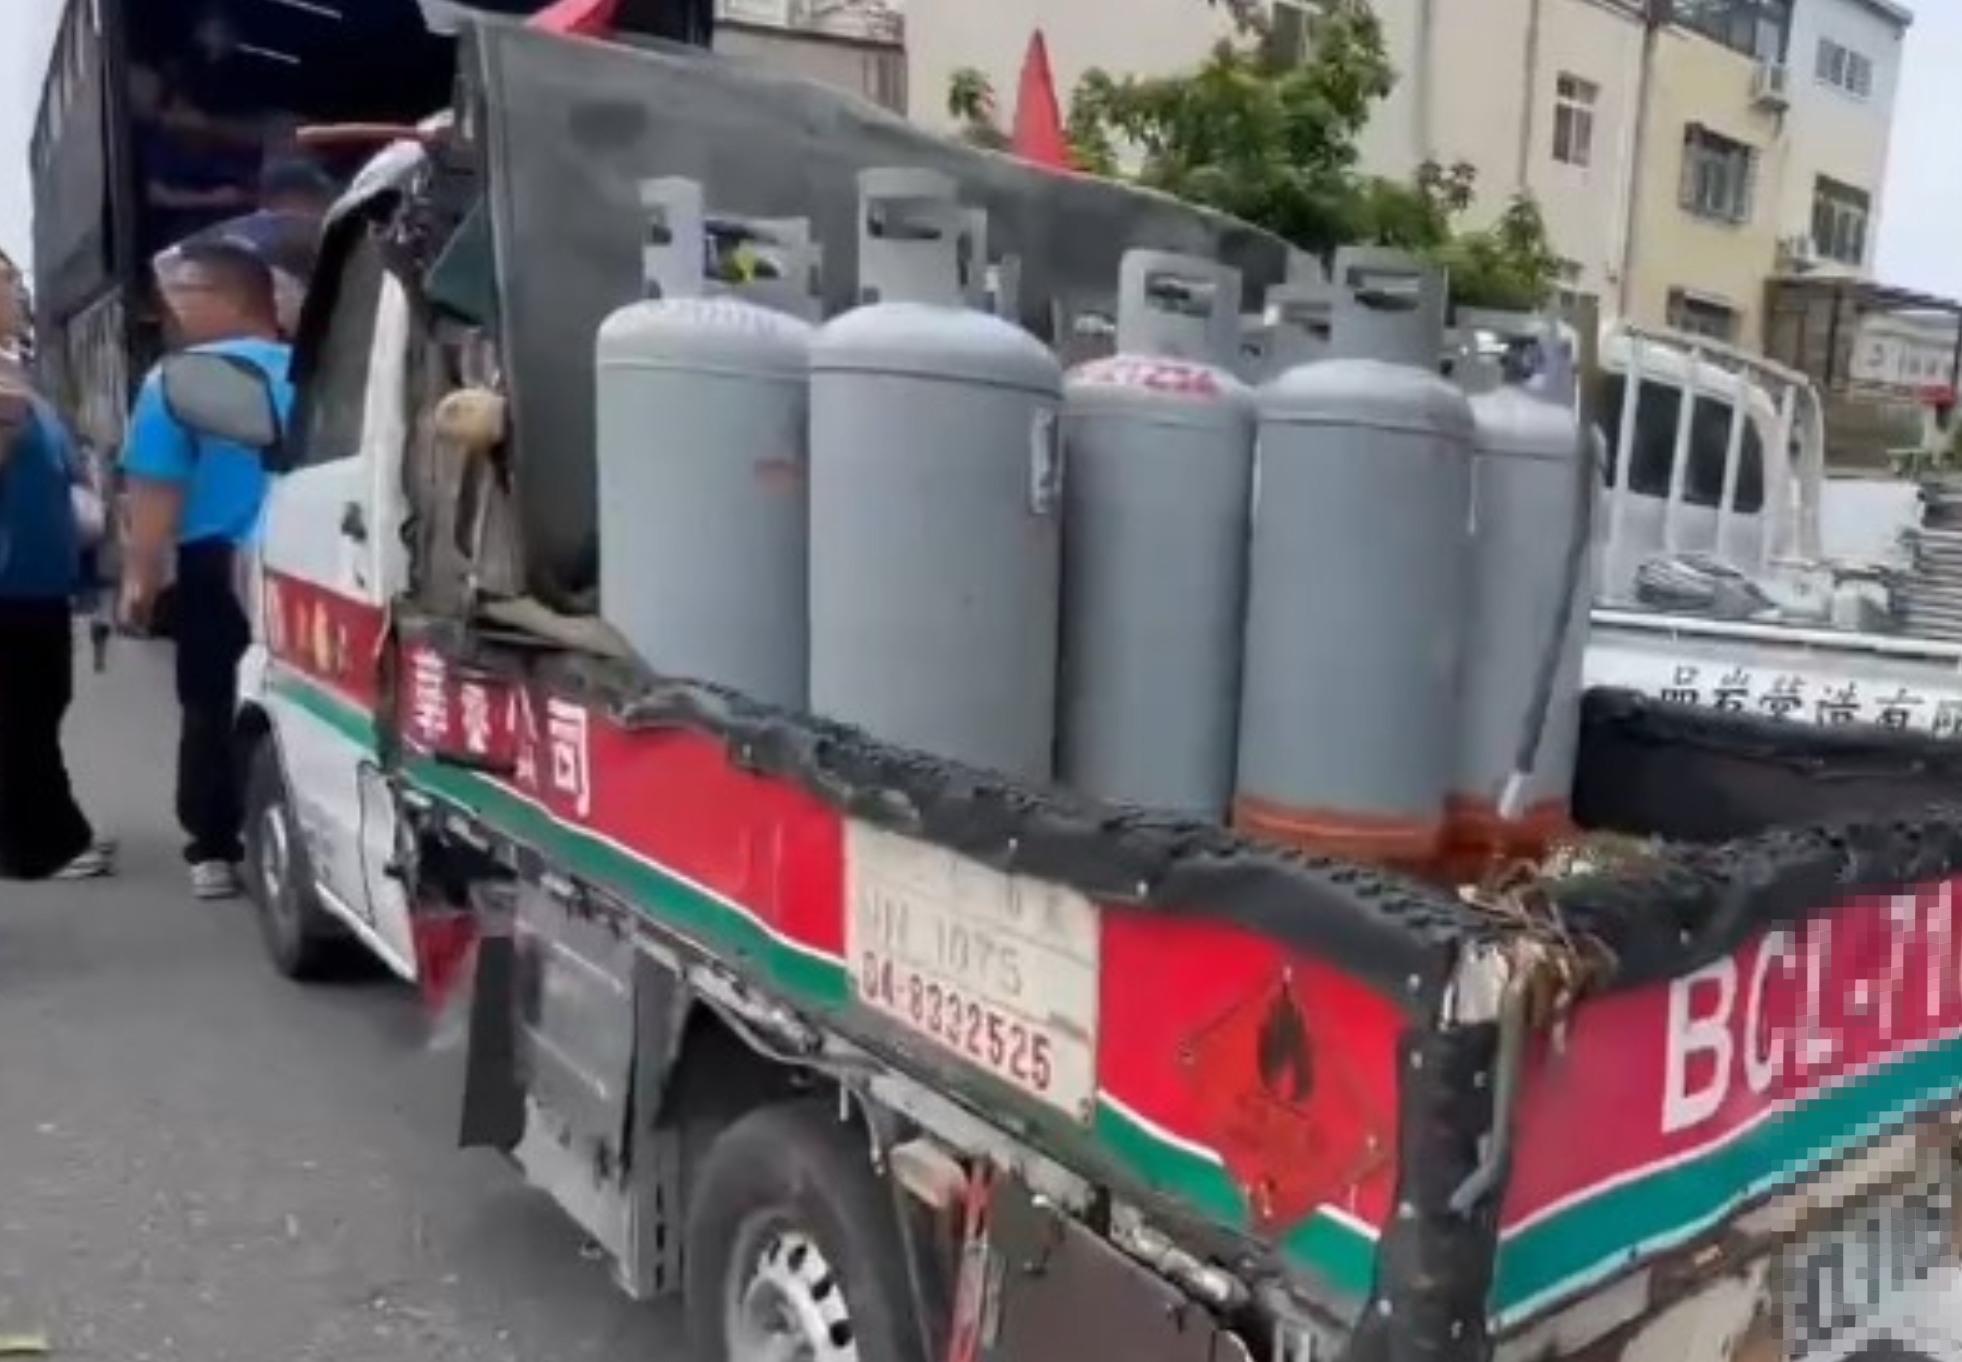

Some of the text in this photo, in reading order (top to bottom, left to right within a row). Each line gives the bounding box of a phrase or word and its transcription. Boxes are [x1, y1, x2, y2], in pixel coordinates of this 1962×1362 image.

[861, 949, 1052, 1091] 04-8332525
[935, 914, 1022, 997] 1075
[1662, 880, 1962, 1134] BCL-71
